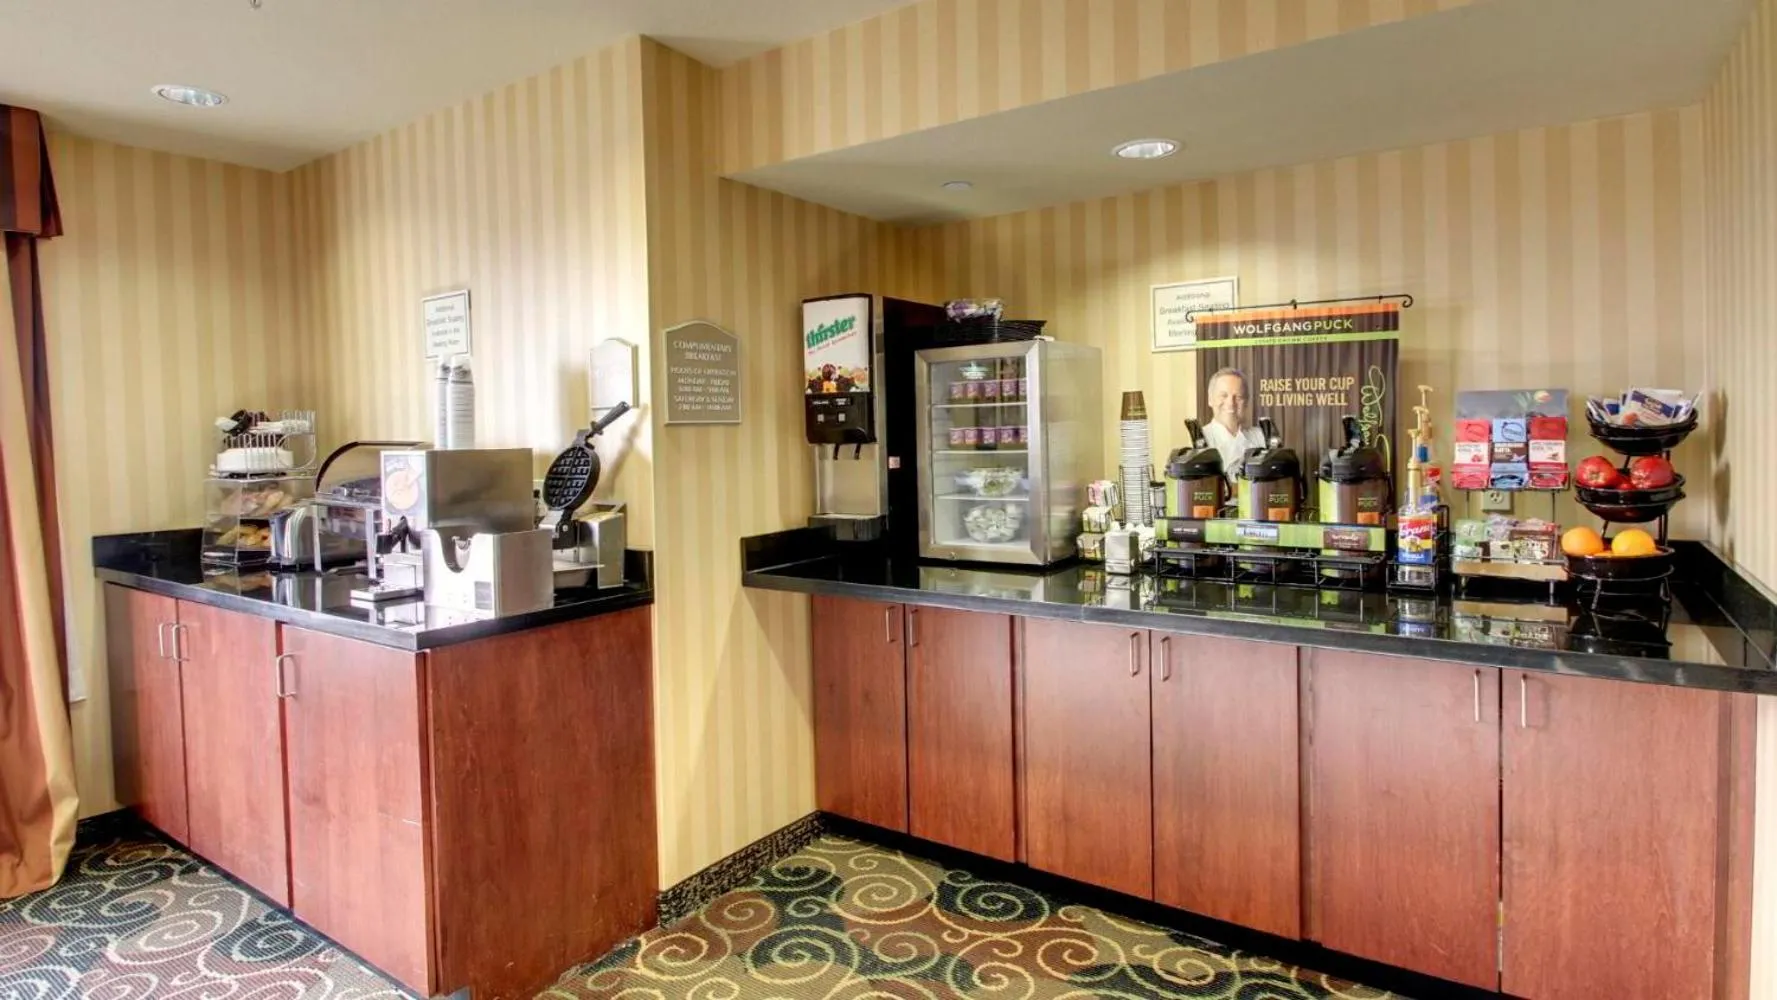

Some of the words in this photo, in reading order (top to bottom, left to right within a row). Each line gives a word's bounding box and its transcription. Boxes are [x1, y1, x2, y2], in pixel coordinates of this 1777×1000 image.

[805, 315, 857, 349] thirster
[672, 340, 732, 353] COMPLIMENTARY
[684, 351, 722, 361] BREAKFAST
[1260, 378, 1293, 392] RAISE
[1295, 377, 1326, 391] YOUR
[1329, 376, 1355, 391] CUP
[1259, 393, 1273, 407] TO
[1276, 392, 1313, 407] LIVING
[1315, 392, 1348, 407] WELL
